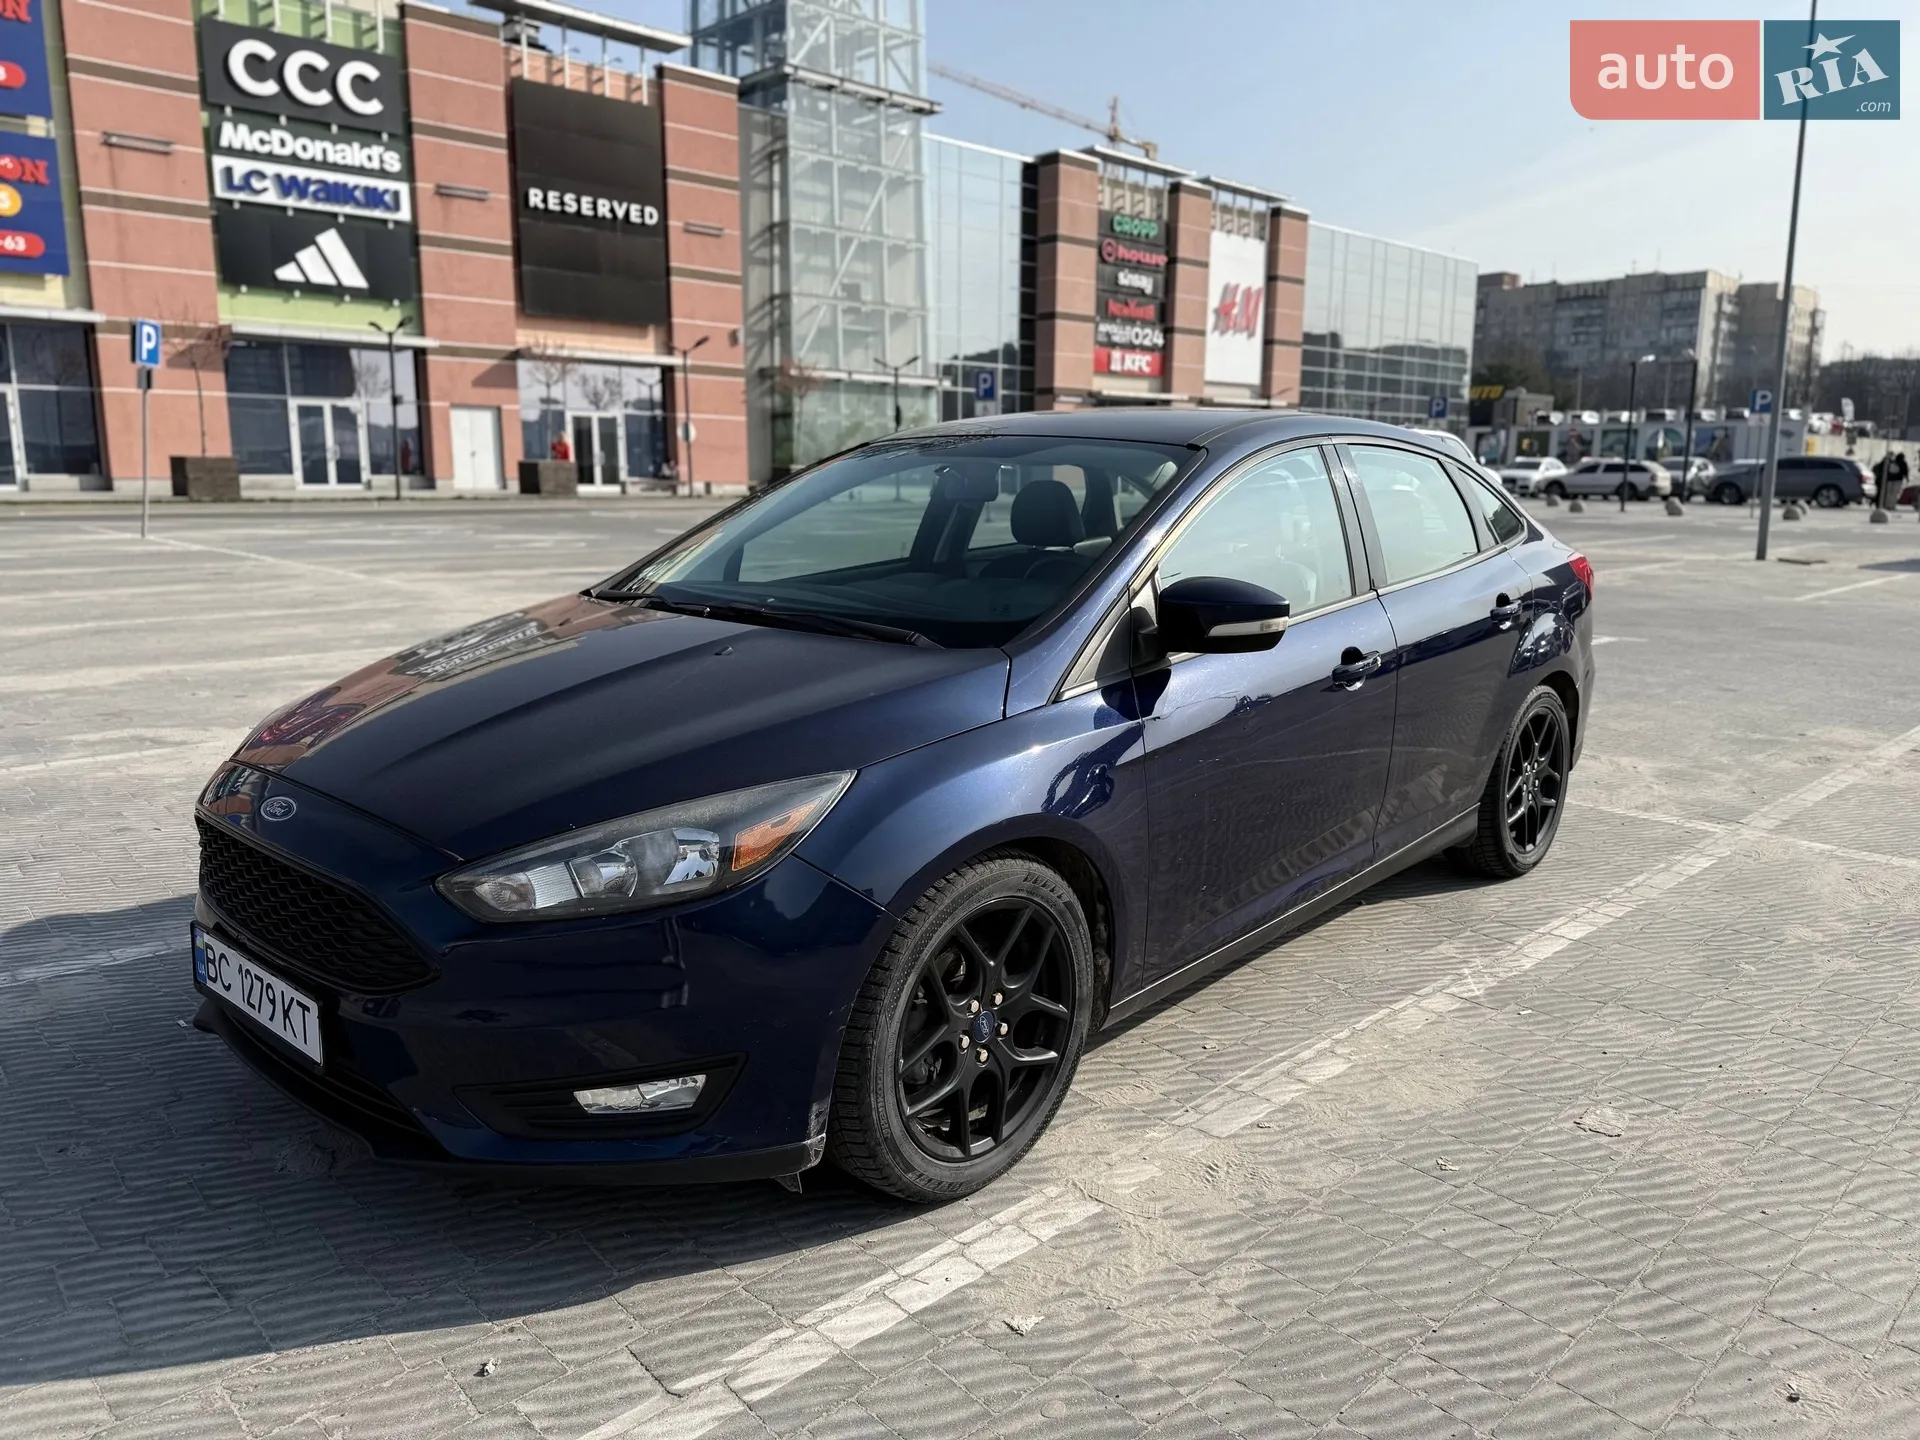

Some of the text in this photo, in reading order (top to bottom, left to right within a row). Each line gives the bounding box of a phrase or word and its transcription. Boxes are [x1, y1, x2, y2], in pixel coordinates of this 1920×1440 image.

[228, 39, 384, 115] CCC
[219, 121, 402, 173] McDonald's
[220, 165, 269, 195] LC
[528, 187, 660, 226] RESERVED
[142, 324, 157, 361] P
[1131, 326, 1165, 348] 024
[1123, 353, 1153, 374] KFC
[978, 372, 992, 398] P
[1432, 398, 1445, 417] P
[1755, 390, 1772, 411] P
[205, 941, 311, 1046] BC 1279 KT
